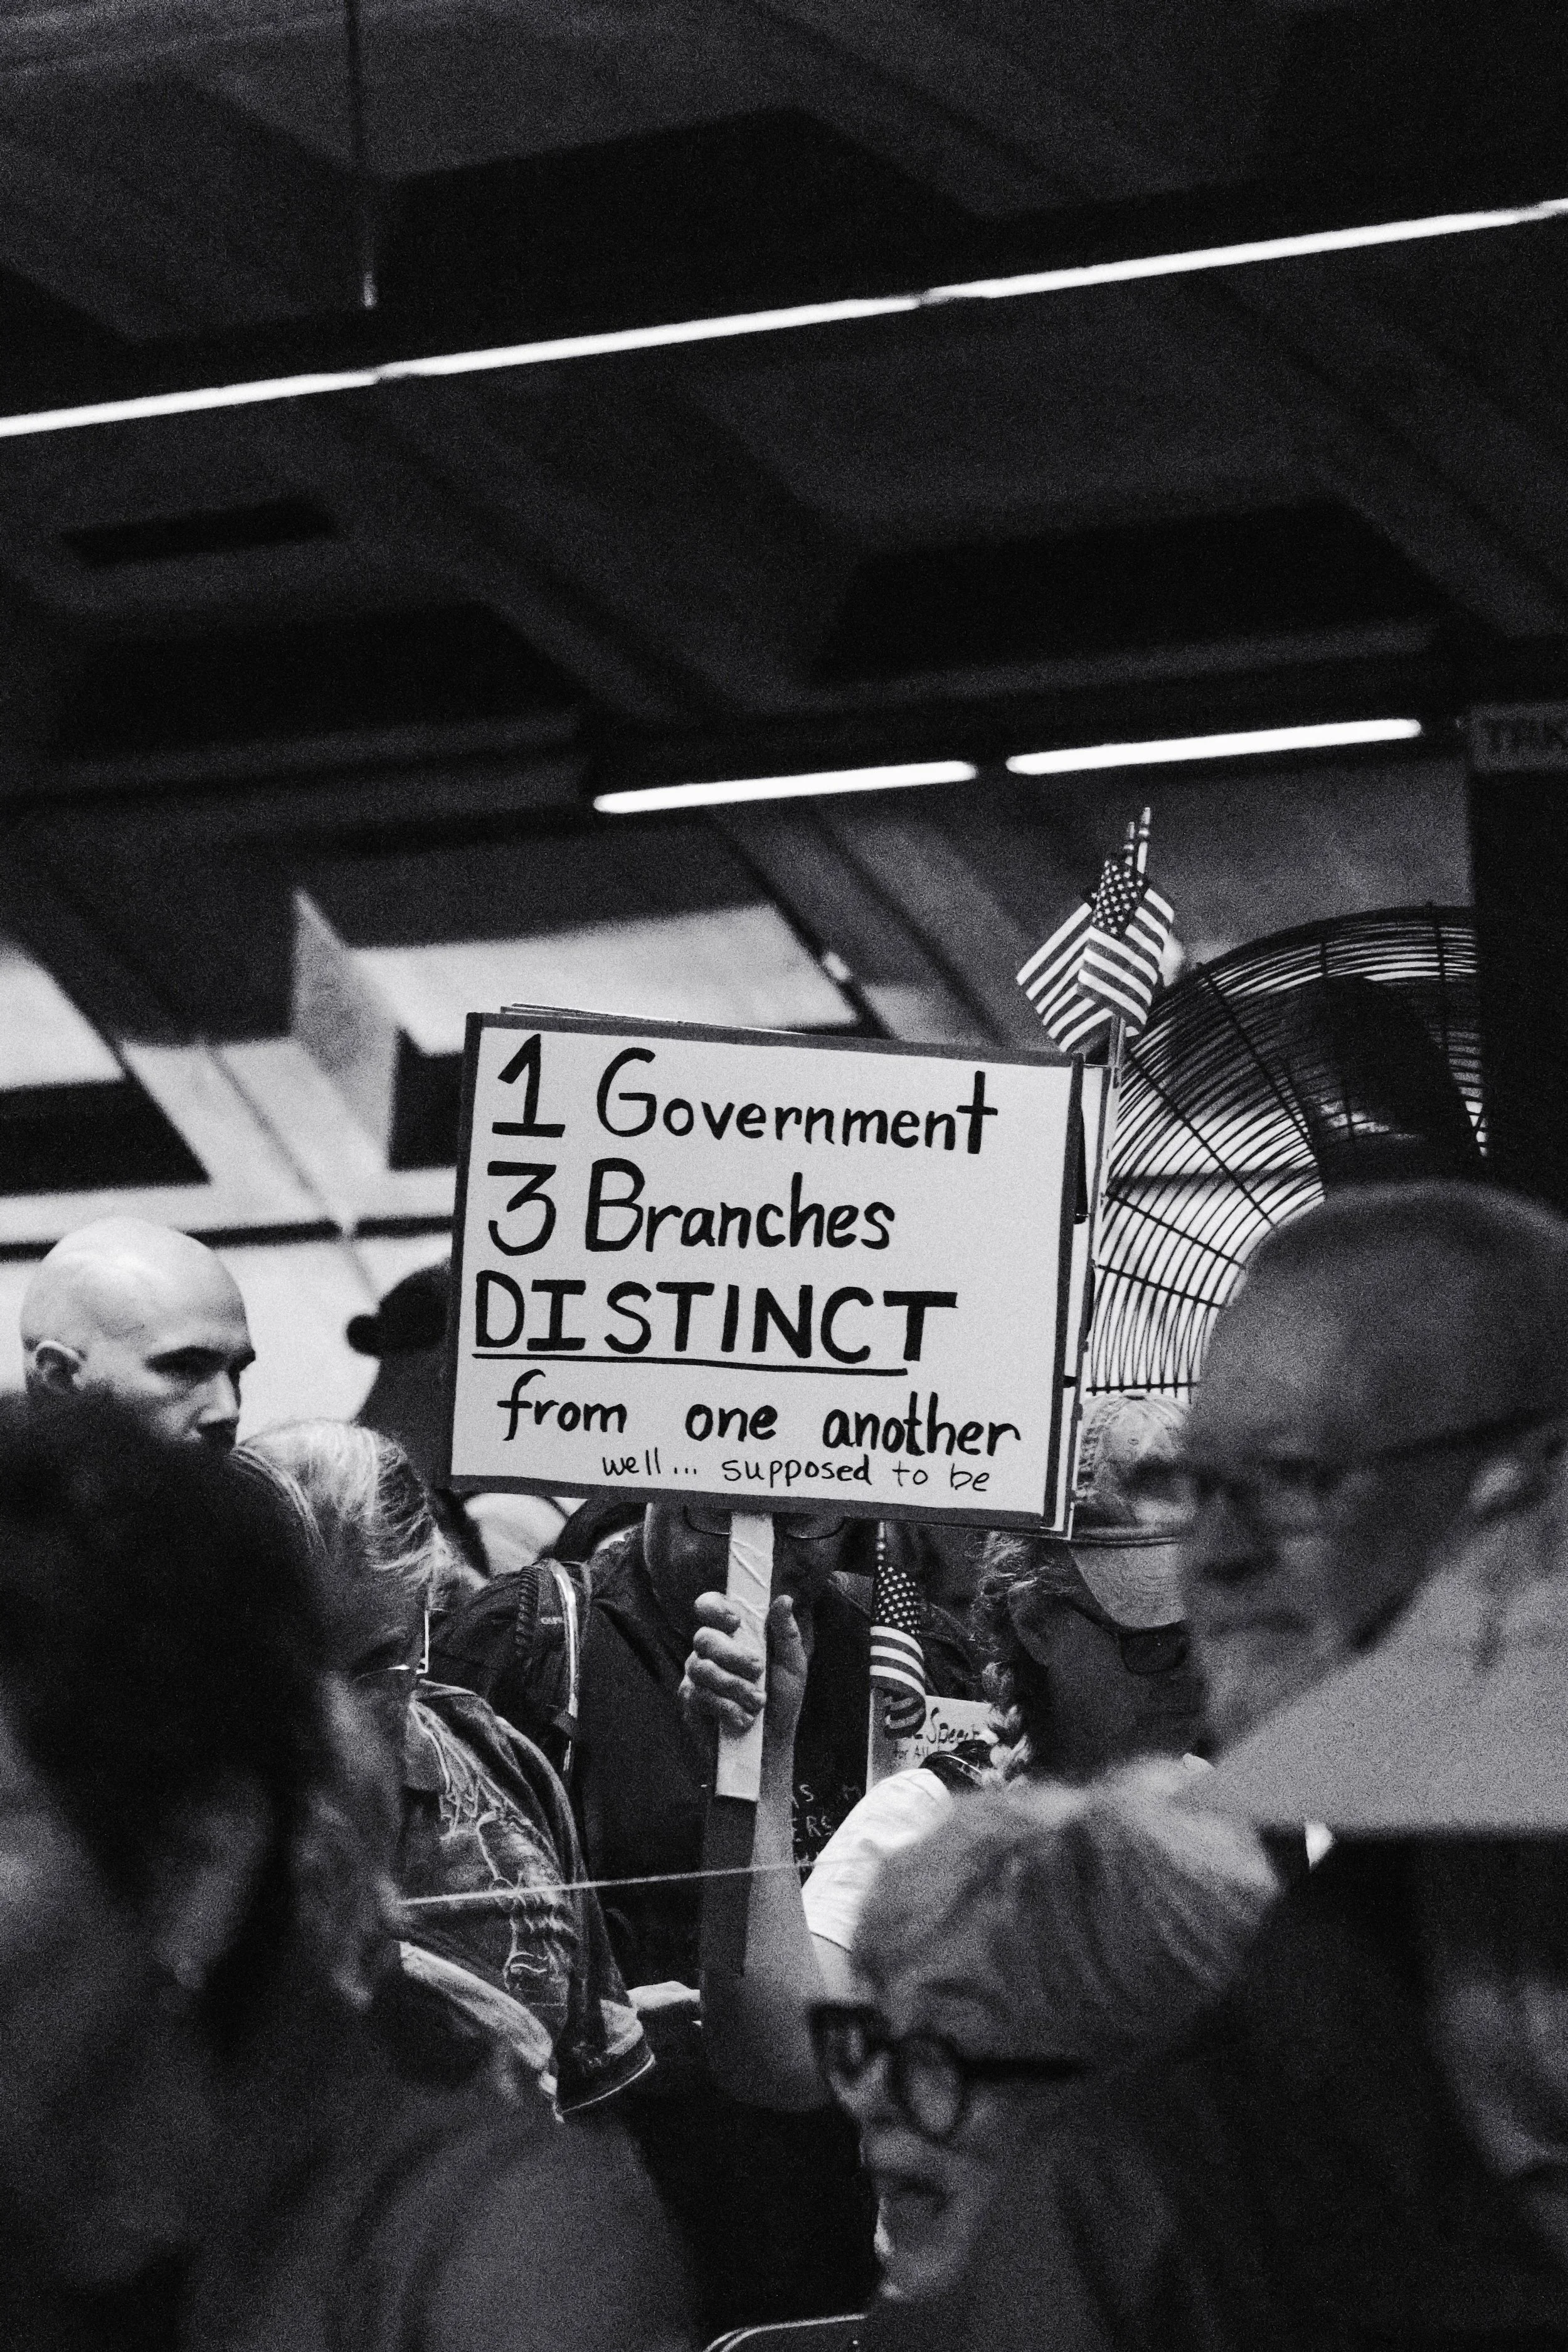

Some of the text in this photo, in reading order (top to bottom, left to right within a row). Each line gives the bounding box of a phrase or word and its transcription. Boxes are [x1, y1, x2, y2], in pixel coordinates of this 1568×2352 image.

[492, 1033, 999, 1155] 1 Government
[487, 1157, 895, 1256] 3 Branches
[475, 1269, 958, 1364] DISTINCT
[497, 1369, 1021, 1456] from one another
[721, 1454, 872, 1488] supposed
[892, 1466, 928, 1486] to
[950, 1464, 990, 1491] be
